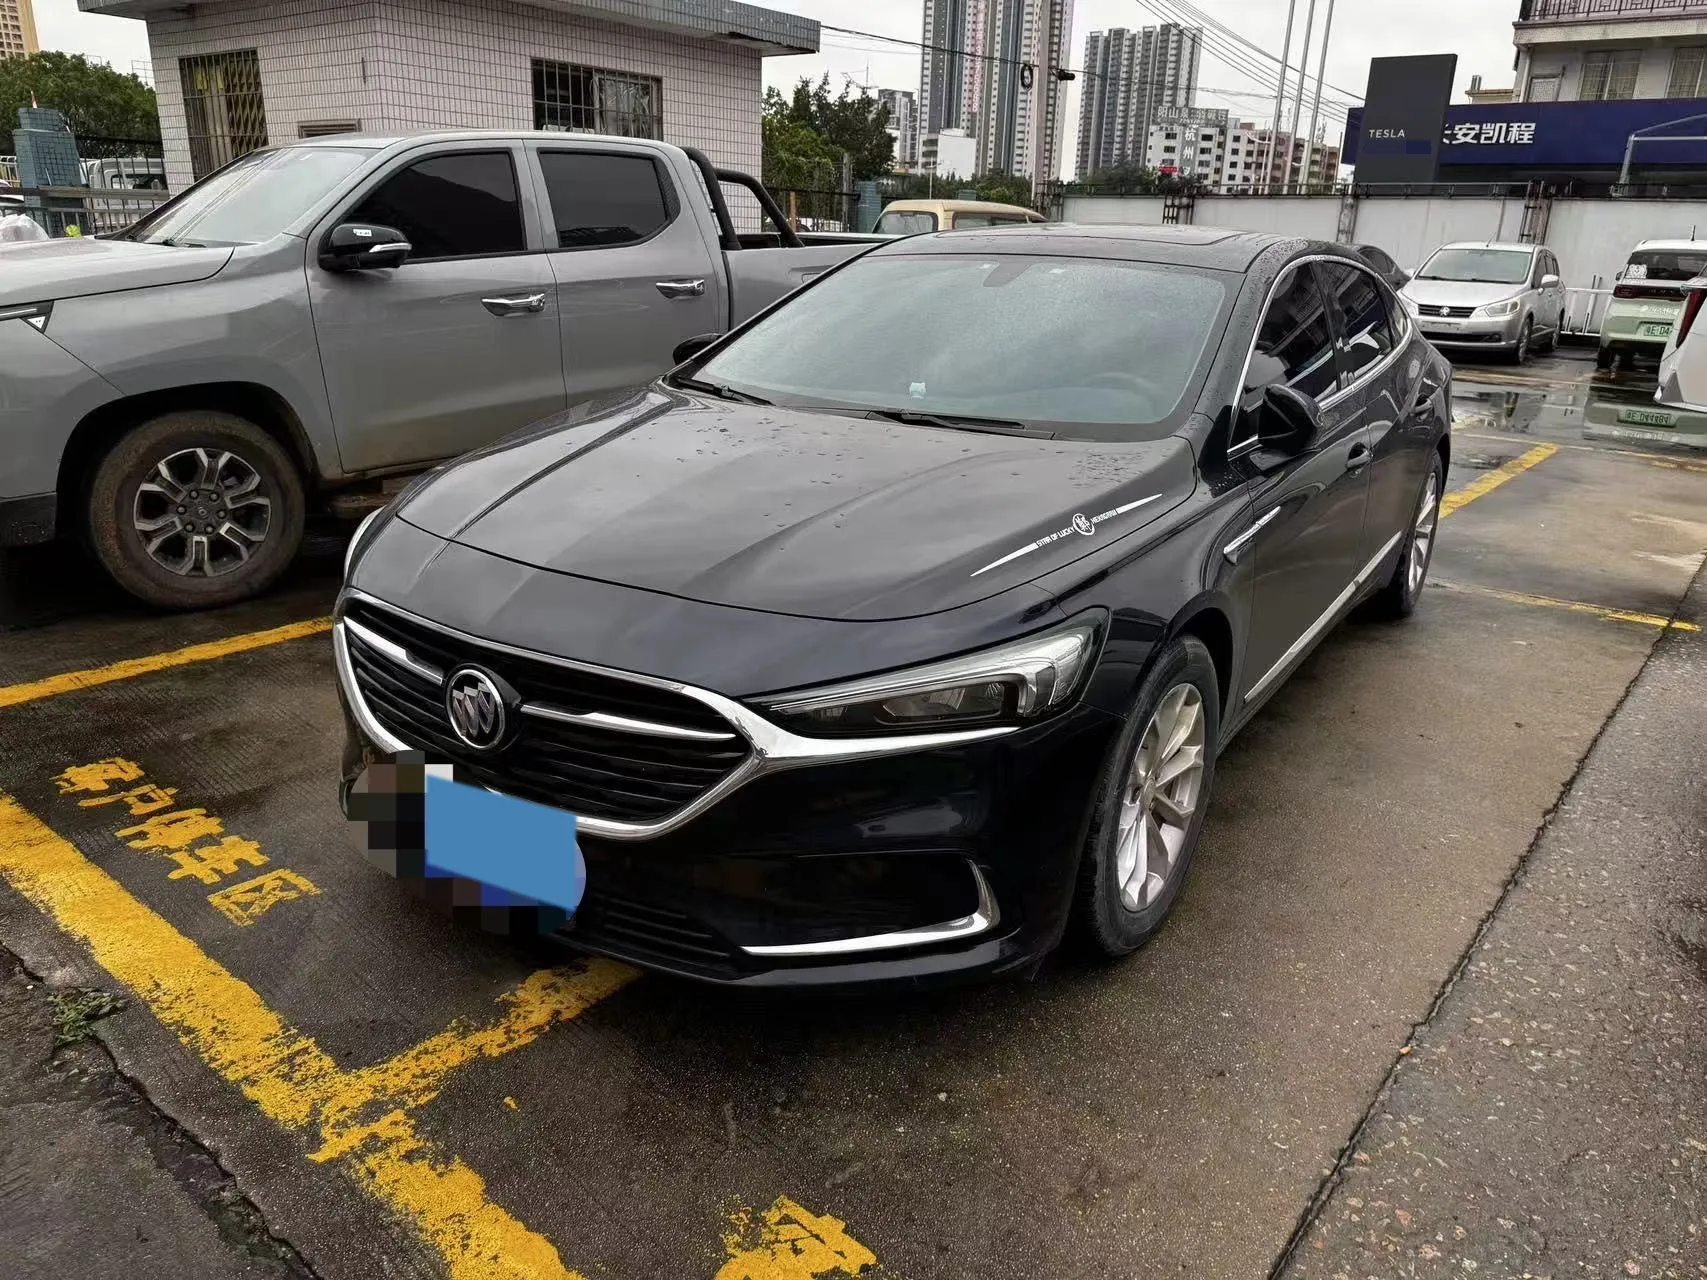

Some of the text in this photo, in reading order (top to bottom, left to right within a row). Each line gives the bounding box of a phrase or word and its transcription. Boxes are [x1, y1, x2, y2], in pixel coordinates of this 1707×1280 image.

[1369, 129, 1405, 139] TESLA
[1036, 526, 1075, 547] STAR OF LUCKY
